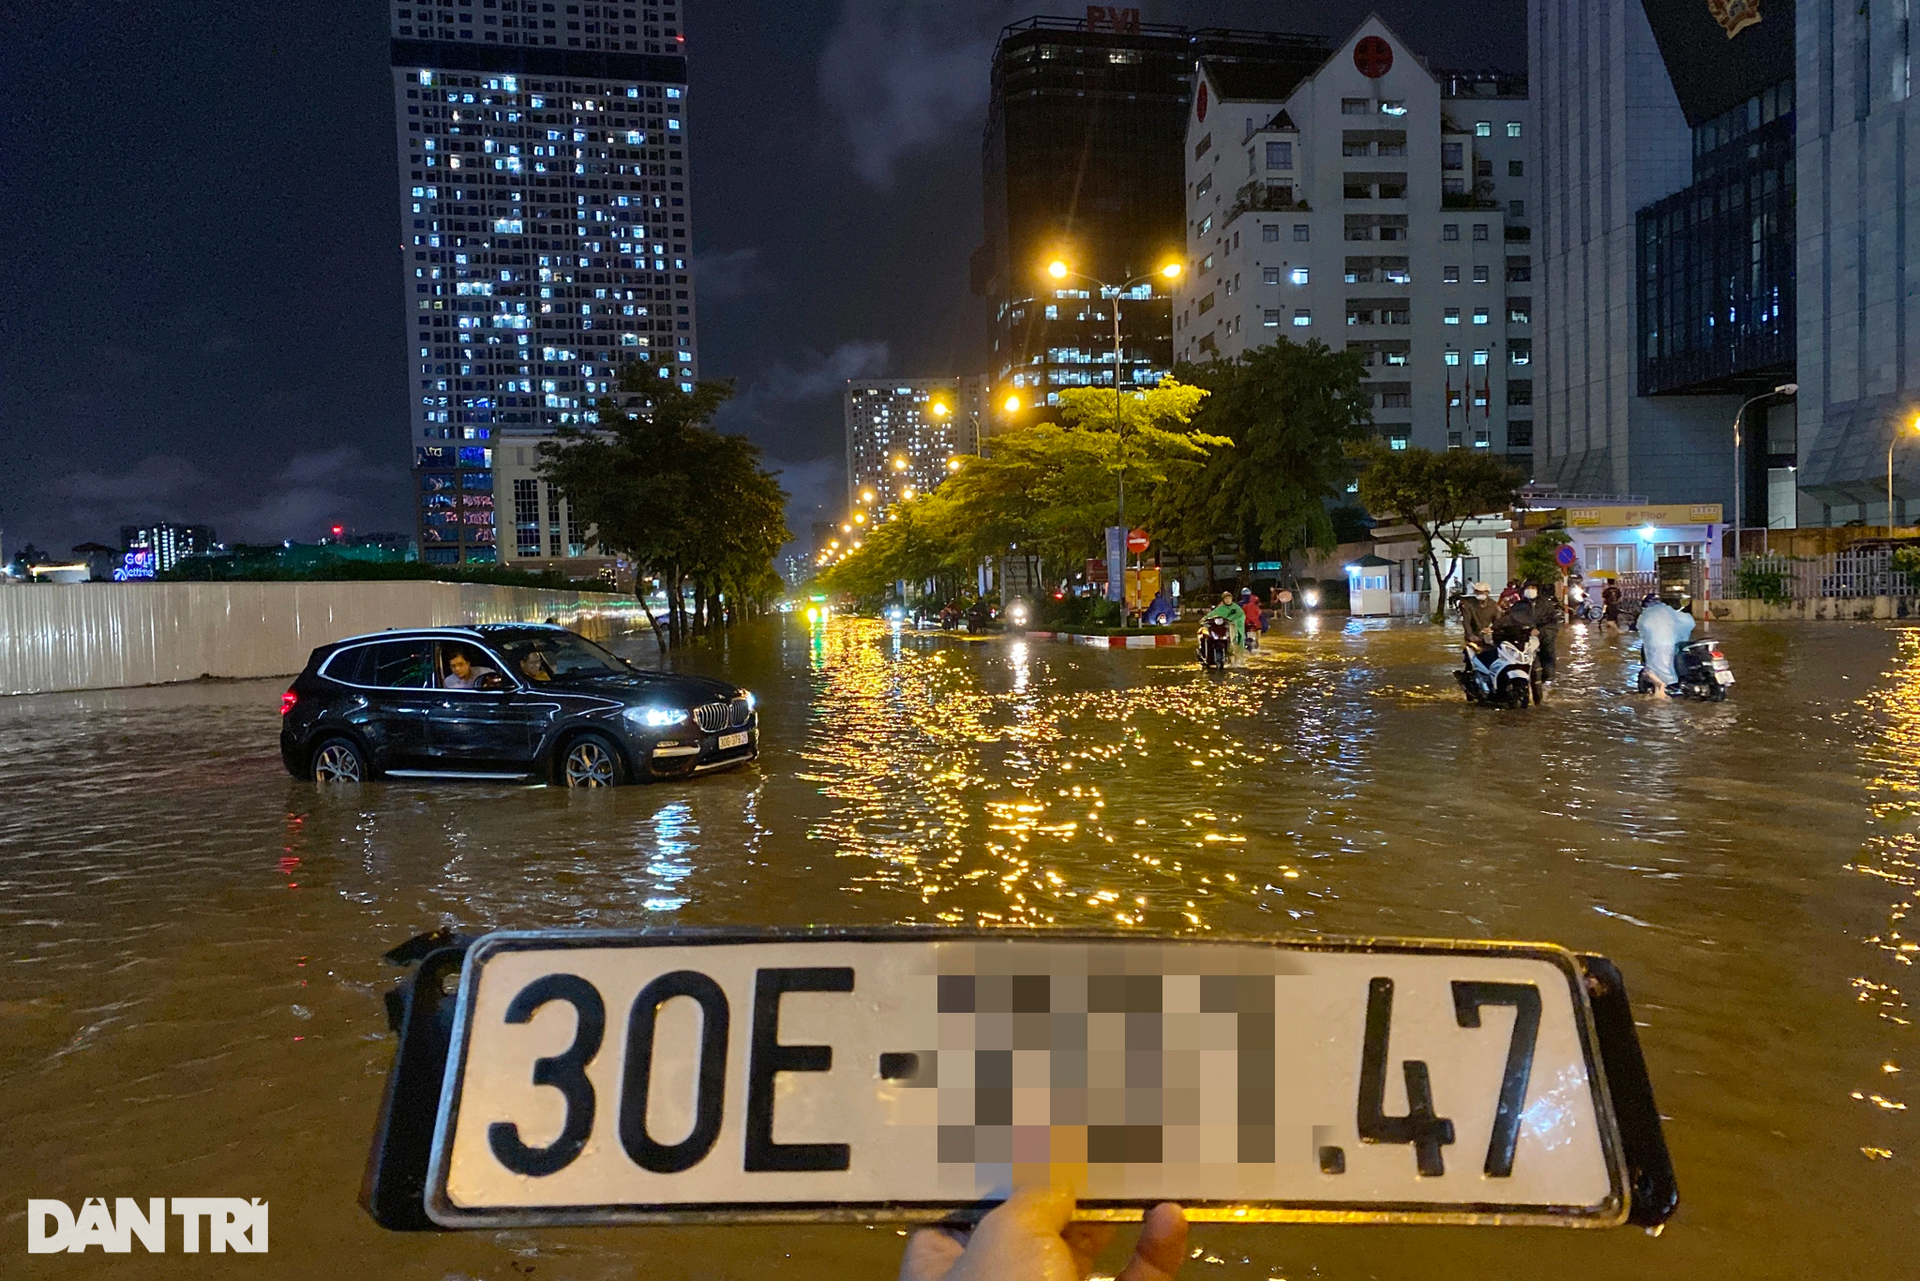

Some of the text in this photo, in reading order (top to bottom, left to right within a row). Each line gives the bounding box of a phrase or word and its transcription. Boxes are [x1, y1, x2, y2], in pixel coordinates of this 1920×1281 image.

[1087, 5, 1140, 35] PVI
[1641, 511, 1667, 520] Floor
[125, 552, 153, 568] GOLF
